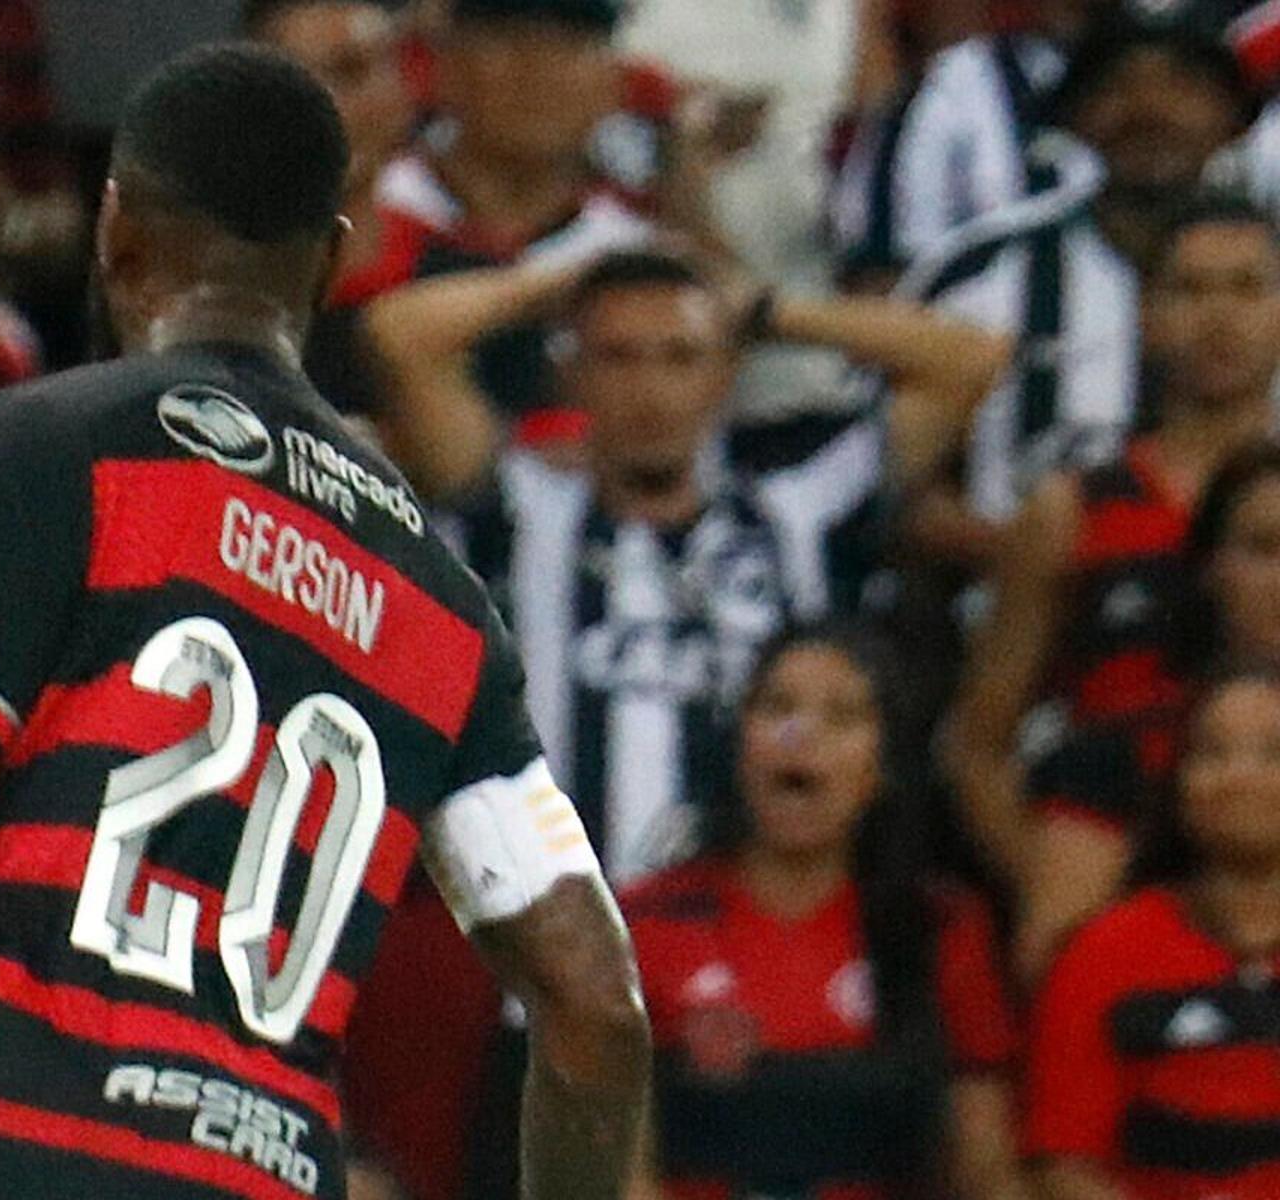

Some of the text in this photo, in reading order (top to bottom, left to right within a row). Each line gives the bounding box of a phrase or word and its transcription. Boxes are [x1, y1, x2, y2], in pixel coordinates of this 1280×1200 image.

[283, 426, 424, 537] mercado
[287, 448, 357, 524] livre
[219, 497, 385, 655] GERSON
[70, 615, 386, 1044] 20
[102, 1063, 309, 1150] ASSIST
[190, 1108, 318, 1196] CARD
